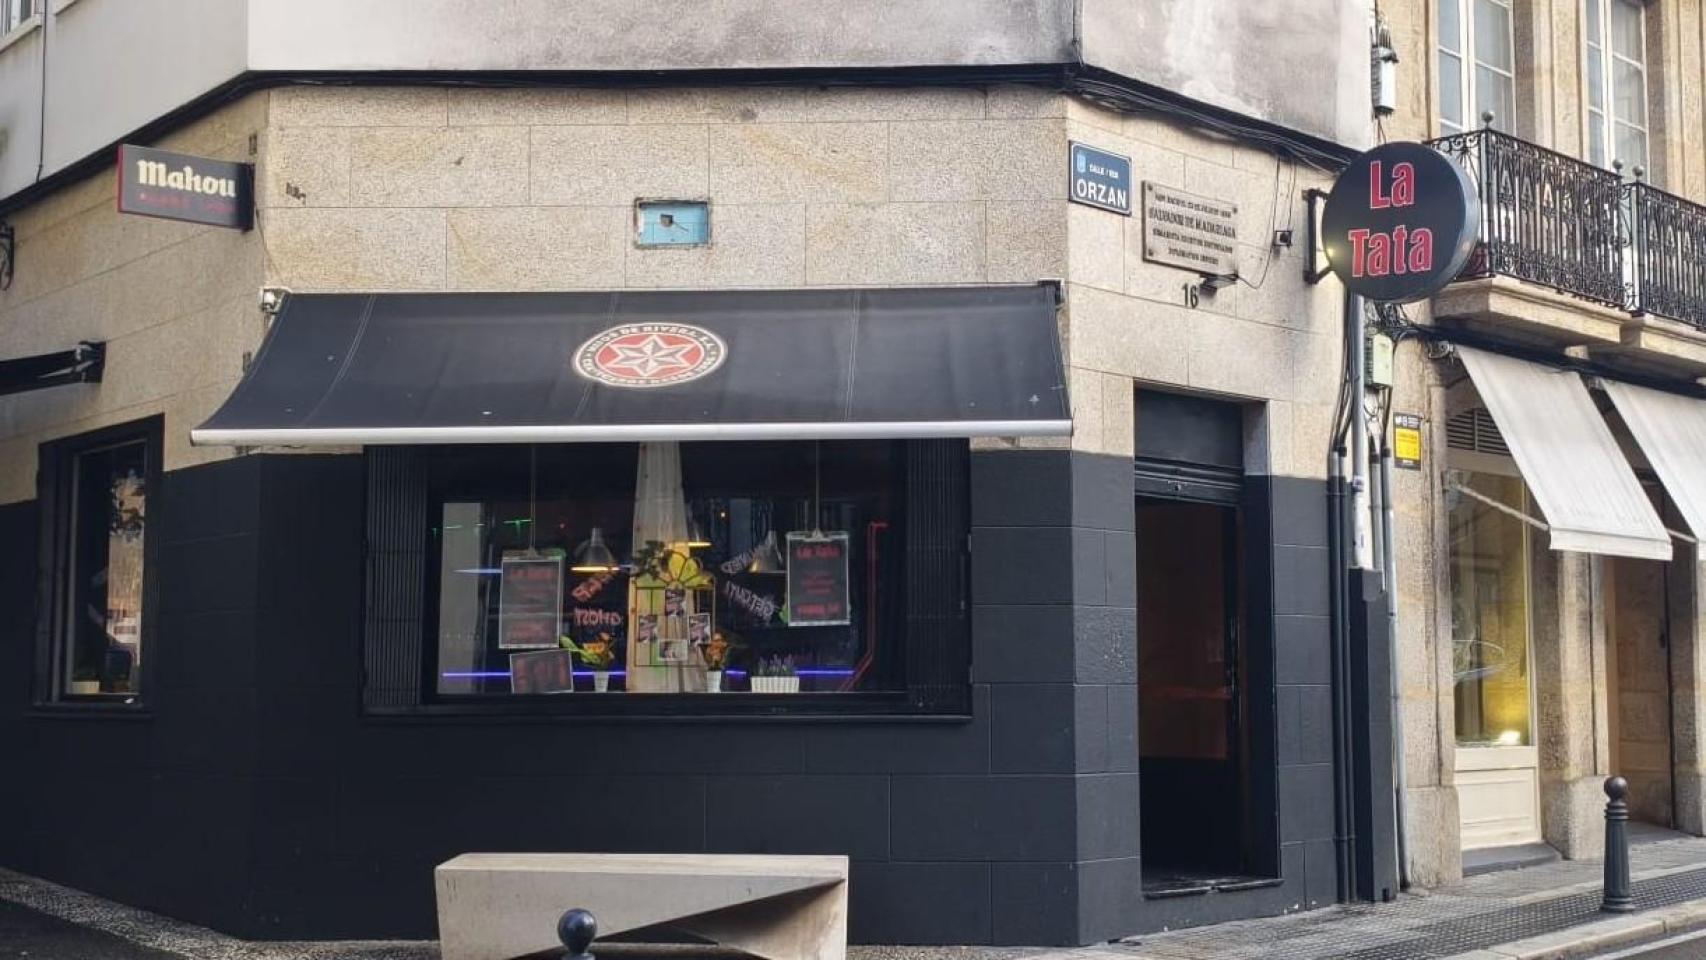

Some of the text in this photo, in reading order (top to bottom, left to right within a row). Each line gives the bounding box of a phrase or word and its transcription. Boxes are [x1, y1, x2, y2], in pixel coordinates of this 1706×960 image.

[136, 159, 236, 198] Mahou
[1077, 178, 1127, 209] ORZAN
[1370, 160, 1415, 209] La
[1348, 225, 1433, 278] Tata
[1182, 283, 1199, 309] 16
